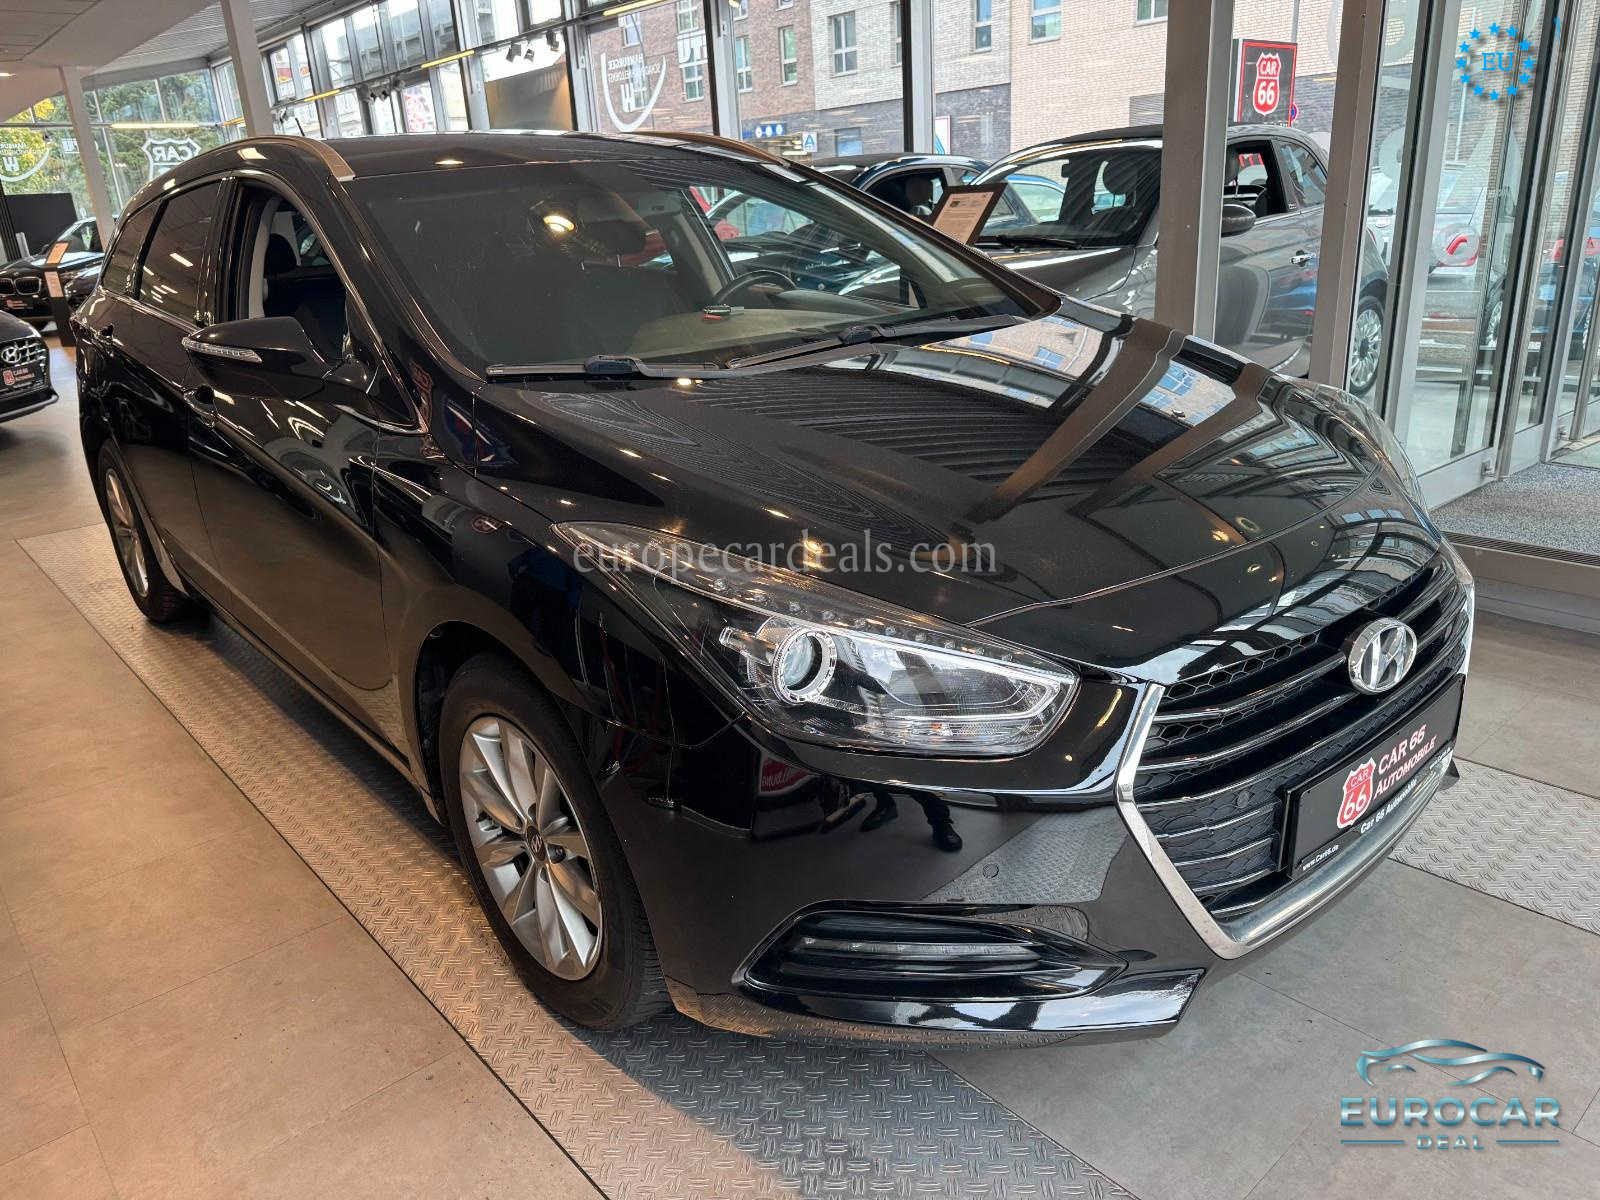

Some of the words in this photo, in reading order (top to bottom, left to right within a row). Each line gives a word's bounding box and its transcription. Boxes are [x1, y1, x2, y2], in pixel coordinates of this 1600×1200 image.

[1260, 60, 1277, 76] CAR
[1257, 81, 1276, 106] 66
[1378, 739, 1408, 775] CAR
[1409, 724, 1427, 751] 66
[1350, 769, 1369, 787] CAR
[1373, 734, 1437, 800] AUTOMOBILE
[1343, 783, 1367, 820] 66
[1360, 818, 1375, 833] Car
